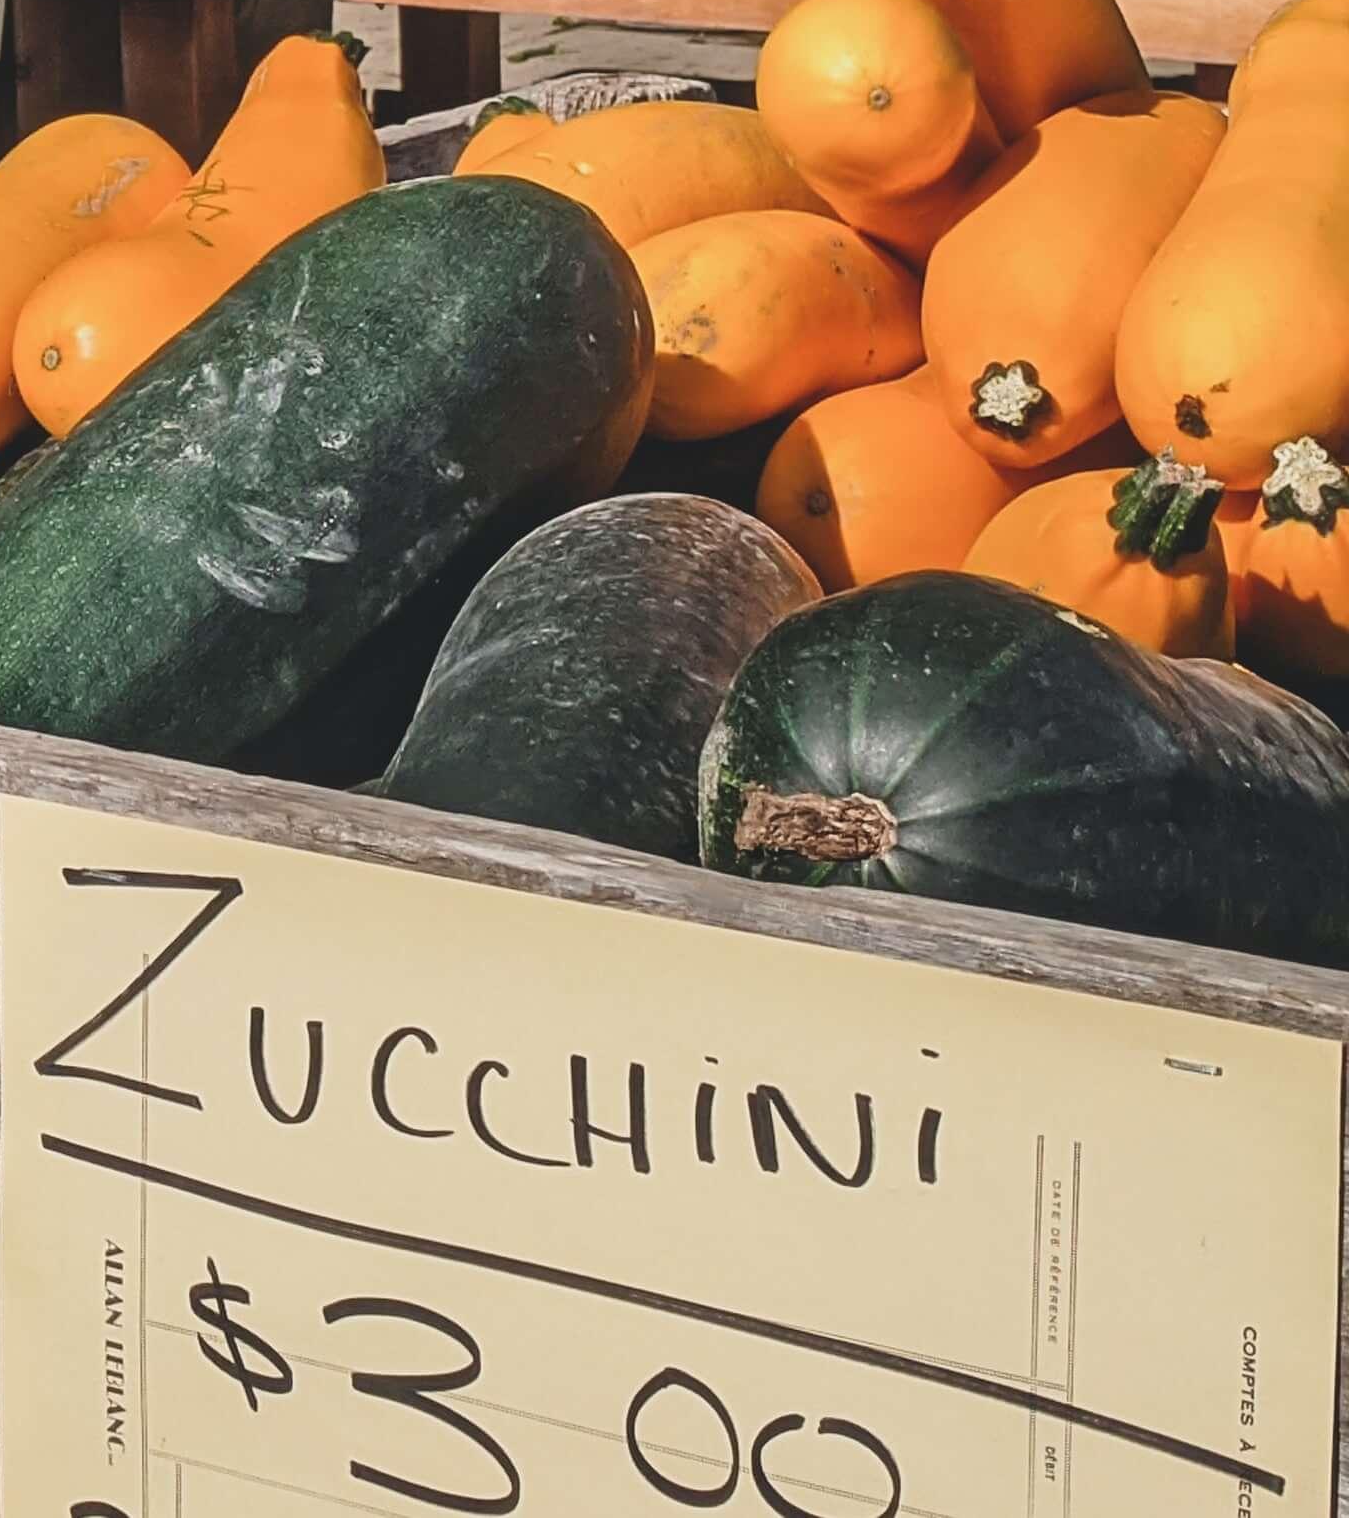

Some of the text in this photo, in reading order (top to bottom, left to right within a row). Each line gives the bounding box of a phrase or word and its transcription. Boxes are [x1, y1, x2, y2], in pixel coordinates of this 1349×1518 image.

[1051, 1180, 1061, 1219] DATE
[104, 1239, 125, 1328] ALLAN
[1237, 1326, 1258, 1518] COMPTES À ECE
[1044, 1446, 1056, 1482] DÉBIT
